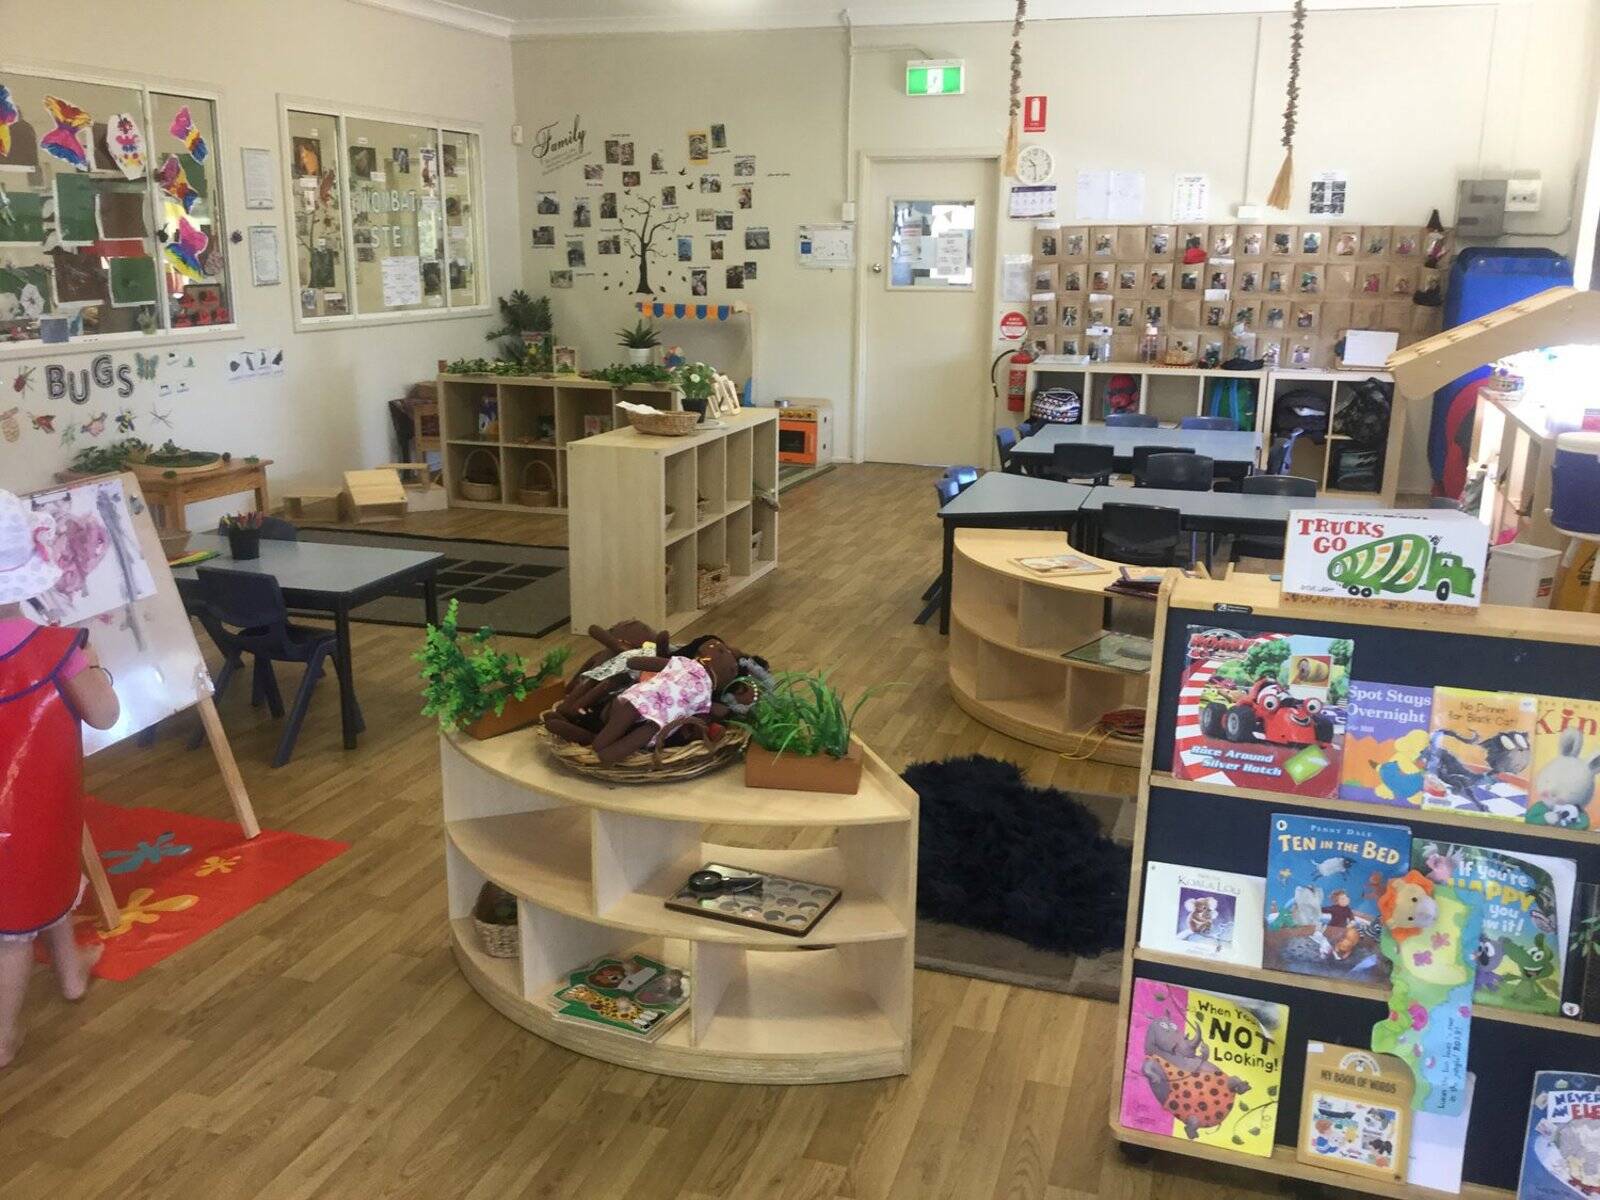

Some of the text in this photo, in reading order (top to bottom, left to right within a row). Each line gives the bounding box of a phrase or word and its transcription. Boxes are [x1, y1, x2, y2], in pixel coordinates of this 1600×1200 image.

[532, 113, 586, 159] Family
[45, 354, 134, 405] BUGS
[1297, 517, 1385, 538] TRUCKS
[1313, 537, 1347, 554] GO
[1349, 685, 1432, 708] Spot Stays
[1460, 702, 1473, 711] No
[1347, 703, 1426, 724] Overnight
[1190, 745, 1275, 763] Race Around
[1202, 757, 1240, 771] Silver
[1278, 834, 1400, 864] TEN IN THE BED
[1458, 860, 1529, 887] If you're
[1488, 904, 1519, 919] you
[1502, 919, 1525, 936] it!
[1198, 1000, 1232, 1017] When
[1208, 1017, 1275, 1055] NOT
[1214, 1047, 1278, 1073] Looking!
[1334, 1072, 1356, 1086] BOOK
